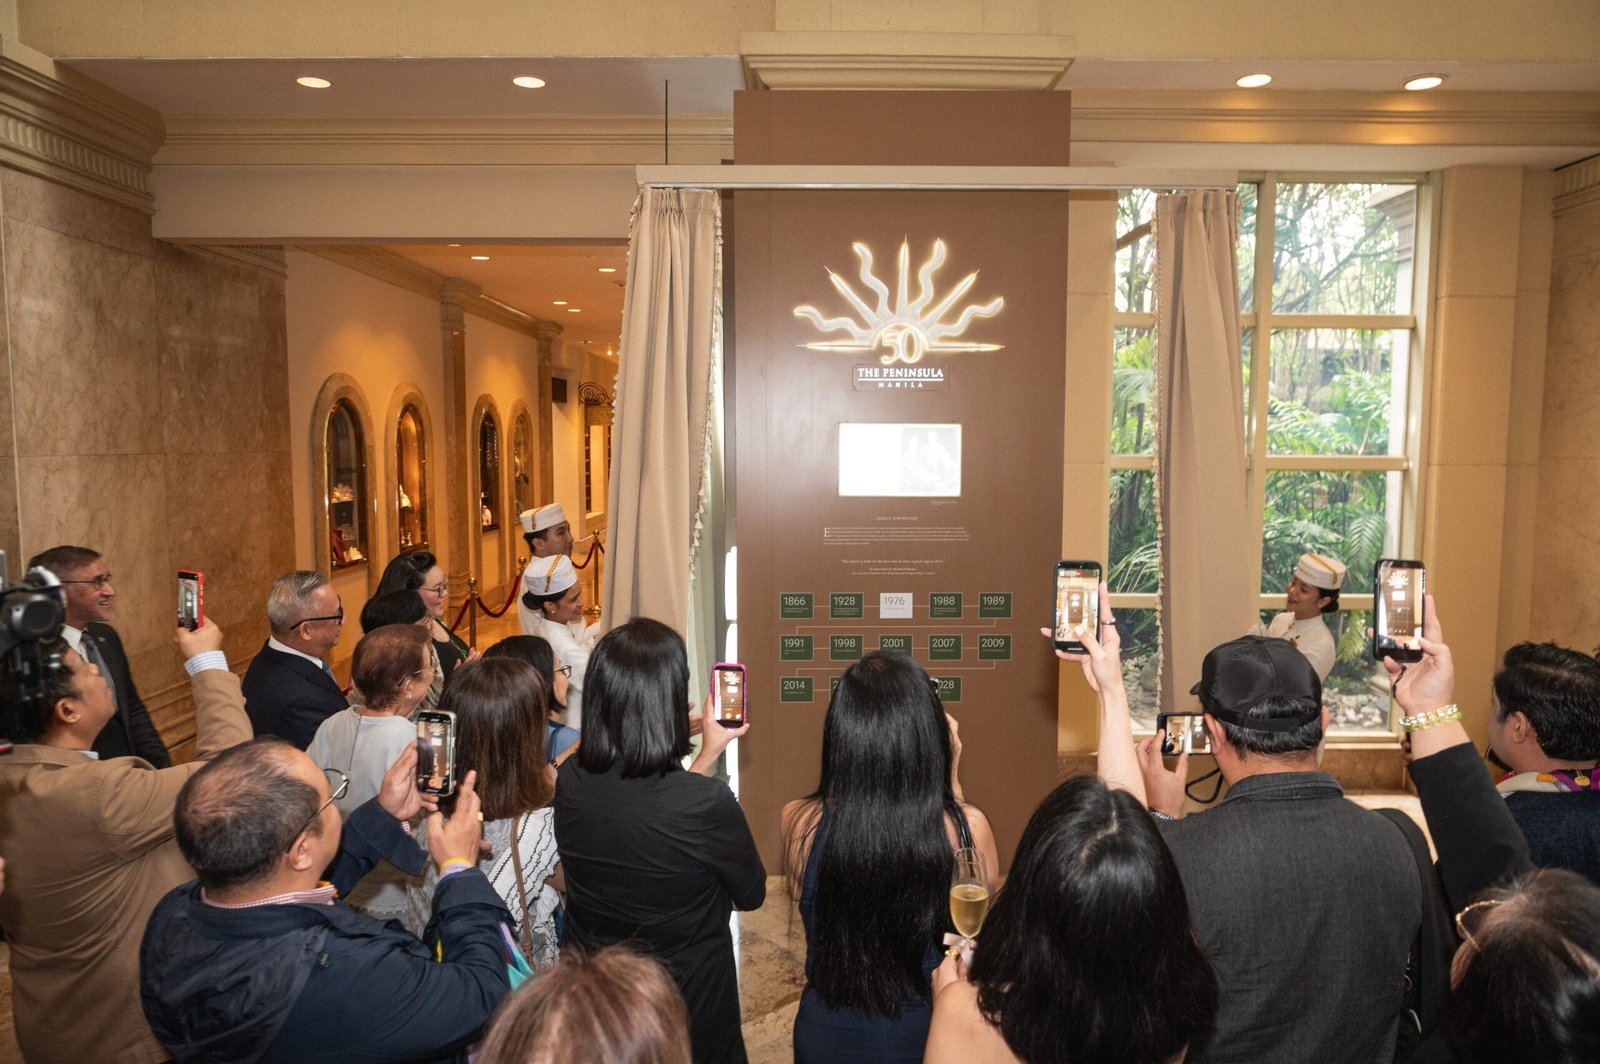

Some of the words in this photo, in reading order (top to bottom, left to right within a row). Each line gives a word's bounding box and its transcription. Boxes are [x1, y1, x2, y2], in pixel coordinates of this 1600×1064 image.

[880, 327, 922, 365] 50
[857, 367, 880, 378] THE
[882, 367, 944, 378] PENINSULA
[783, 596, 806, 606] 1866
[833, 596, 856, 606] 1928
[883, 596, 905, 606] 1976
[933, 596, 956, 606] 1988
[982, 596, 1005, 606] 1989
[783, 638, 805, 648] 1991
[833, 638, 856, 648] 1998
[882, 638, 904, 648] 2001
[932, 638, 955, 648] 2007
[981, 638, 1005, 648] 2009
[783, 680, 805, 690] 2014
[938, 680, 955, 689] 028
